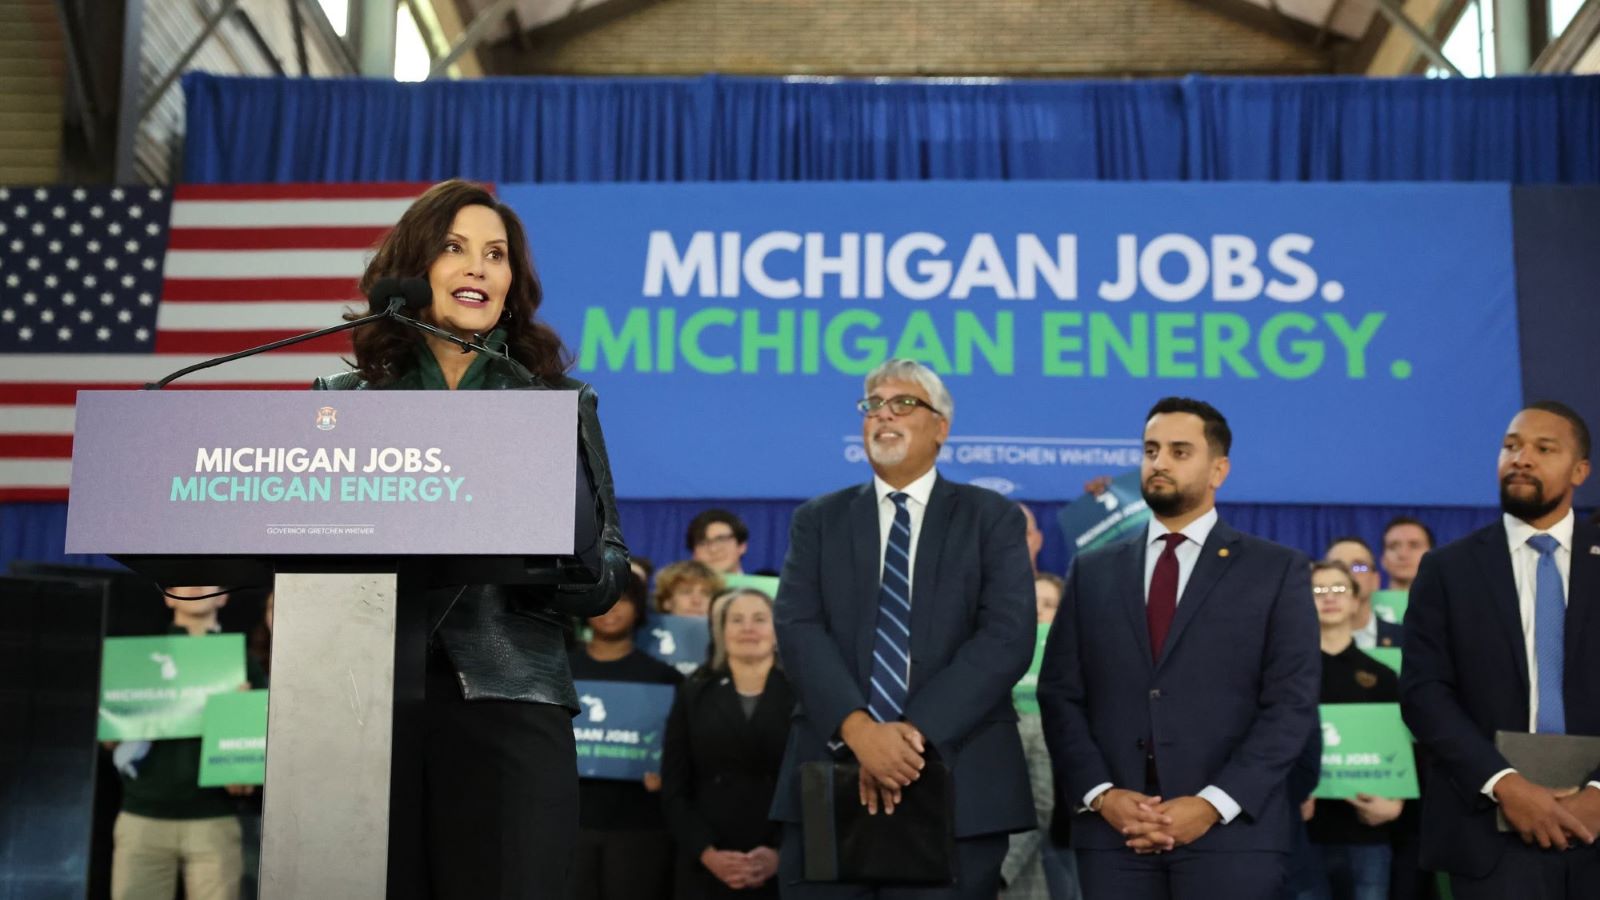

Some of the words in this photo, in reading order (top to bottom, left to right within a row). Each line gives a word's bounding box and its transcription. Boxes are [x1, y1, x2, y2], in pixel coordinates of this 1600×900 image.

[642, 231, 1078, 300] MICHIGAN
[1098, 233, 1345, 302] JOBS.
[578, 307, 1014, 376] MICHIGAN
[1042, 312, 1412, 379] ENERGY.
[195, 447, 355, 473] MICHIGAN
[363, 447, 451, 473] JOBS.
[957, 445, 1056, 464] GRETCHEN
[1060, 447, 1141, 466] WHITMER
[170, 476, 330, 502] MICHIGAN
[340, 476, 473, 502] ENERGY.
[266, 527, 306, 535] GOVERNOR
[307, 527, 344, 535] GRETCHEN
[1345, 752, 1380, 766] JOBS
